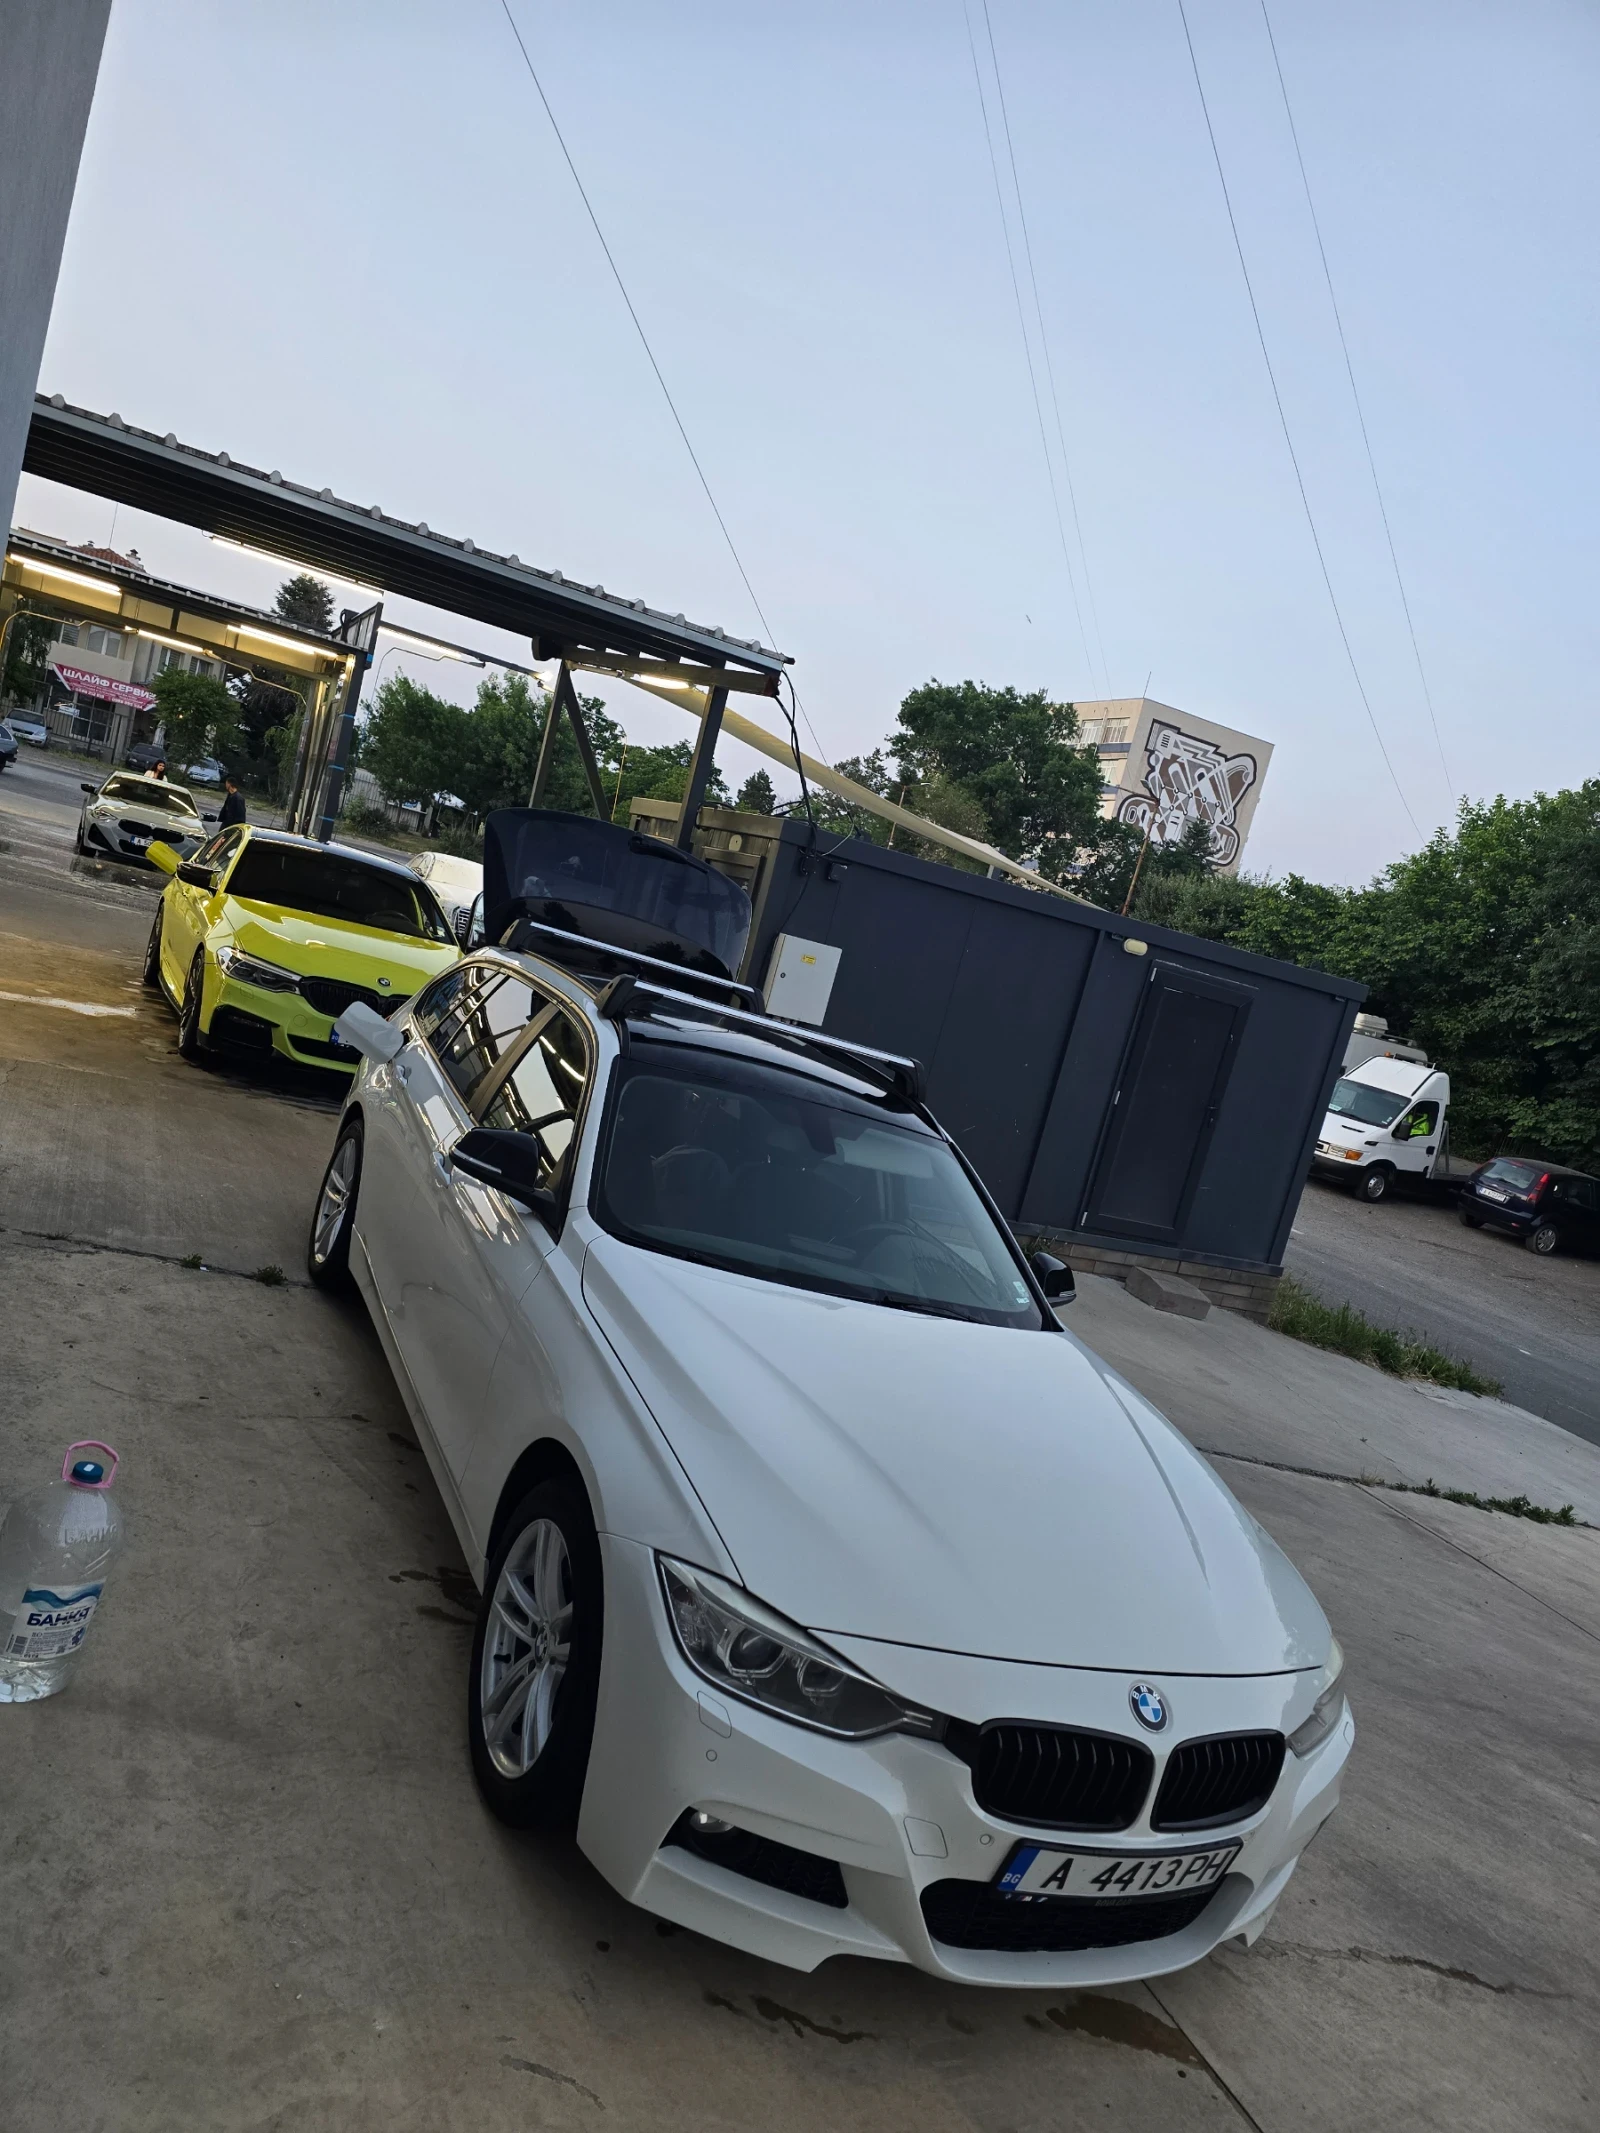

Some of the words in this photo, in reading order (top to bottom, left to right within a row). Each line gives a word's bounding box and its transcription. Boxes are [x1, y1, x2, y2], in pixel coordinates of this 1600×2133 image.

[63, 668, 110, 687] ШЛАЙФ
[1001, 1872, 1021, 1884] BG
[1040, 1858, 1074, 1890] A
